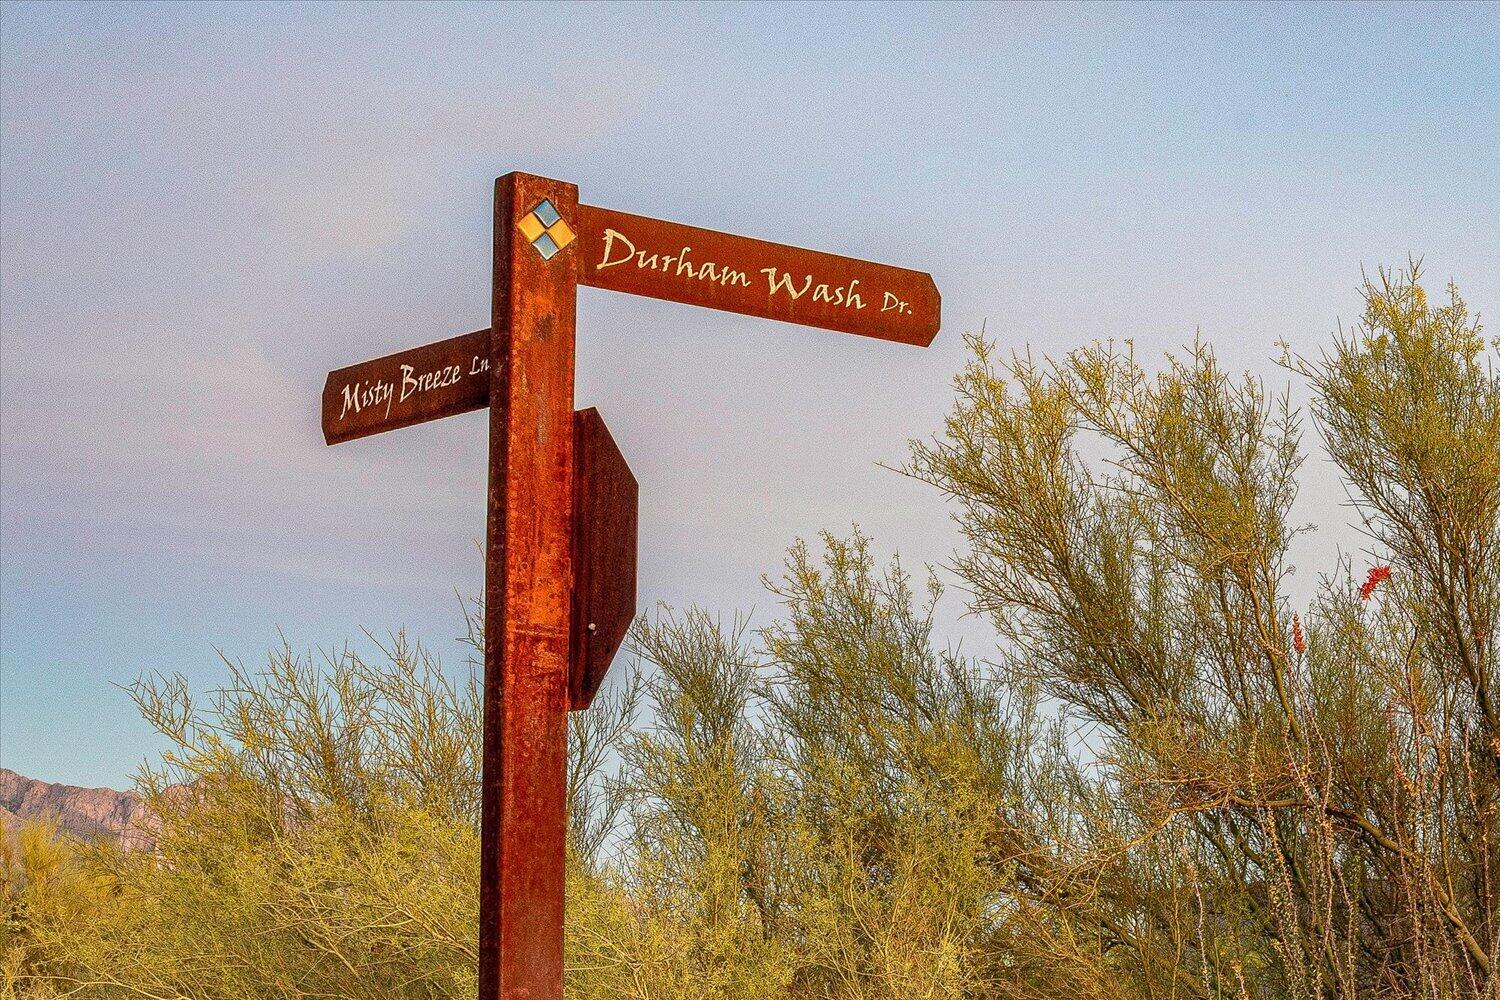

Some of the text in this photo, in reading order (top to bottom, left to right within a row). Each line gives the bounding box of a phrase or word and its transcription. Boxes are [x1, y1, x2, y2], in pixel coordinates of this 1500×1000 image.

[596, 228, 913, 316] Durham Wash Dr.
[339, 379, 394, 421] Misty
[400, 364, 462, 403] Breeze
